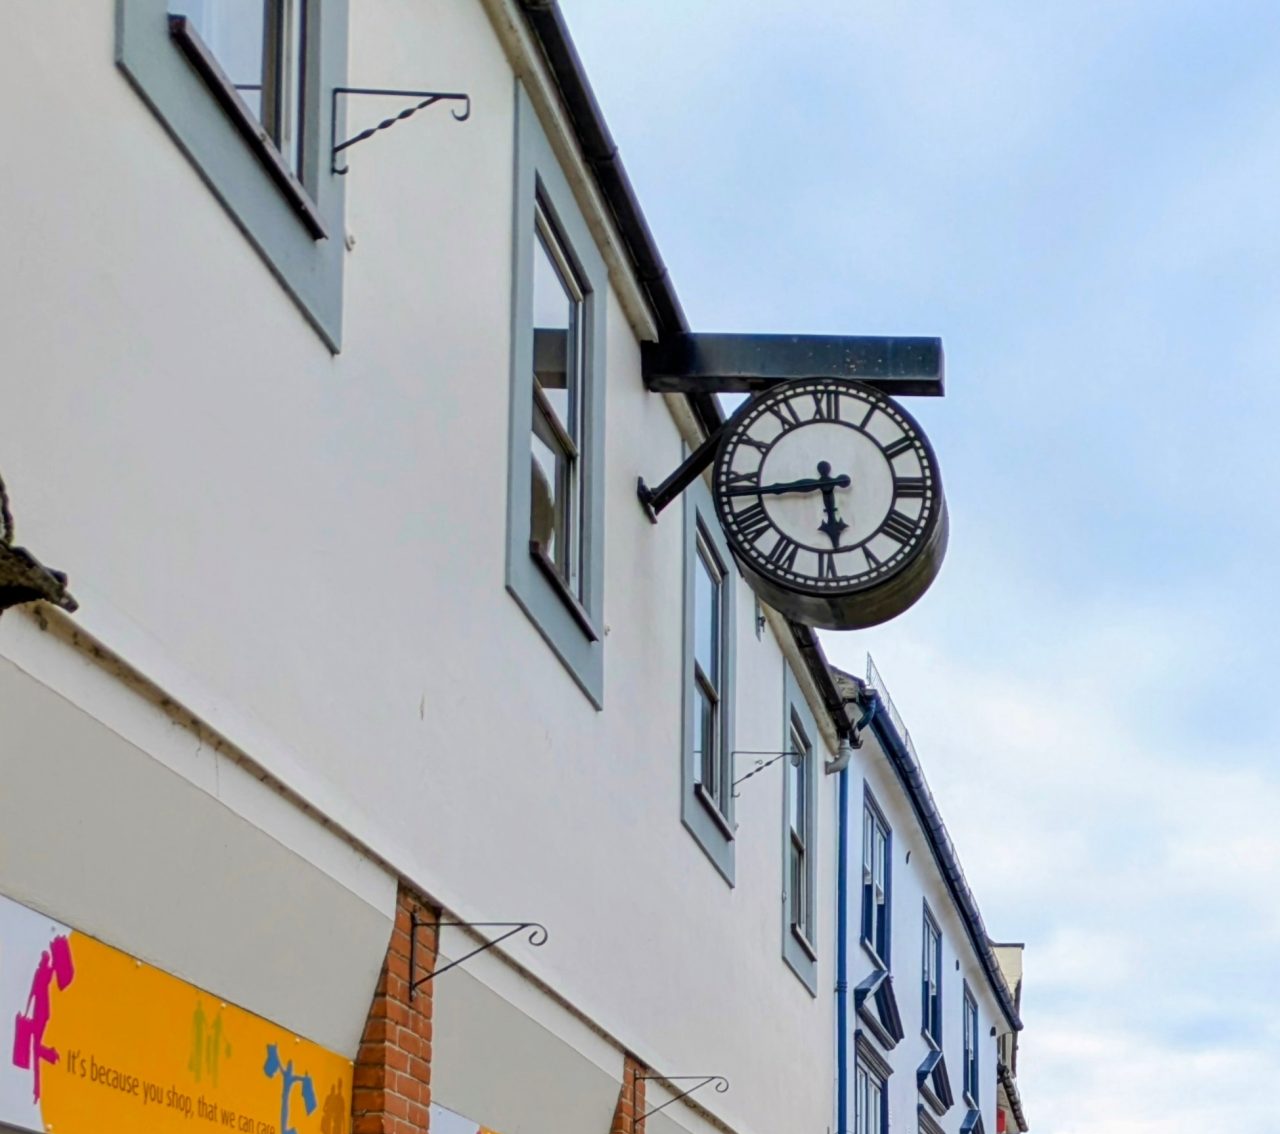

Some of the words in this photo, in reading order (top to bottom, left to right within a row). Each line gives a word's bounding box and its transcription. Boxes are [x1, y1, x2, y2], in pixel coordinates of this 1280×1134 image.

[812, 391, 841, 421] XII
[894, 477, 927, 499] III
[67, 1049, 87, 1078] It's
[90, 1055, 140, 1096] because
[143, 1080, 164, 1105] you
[166, 1084, 195, 1119] shop,
[197, 1096, 218, 1122] that
[220, 1107, 236, 1129] we
[238, 1113, 255, 1134] can
